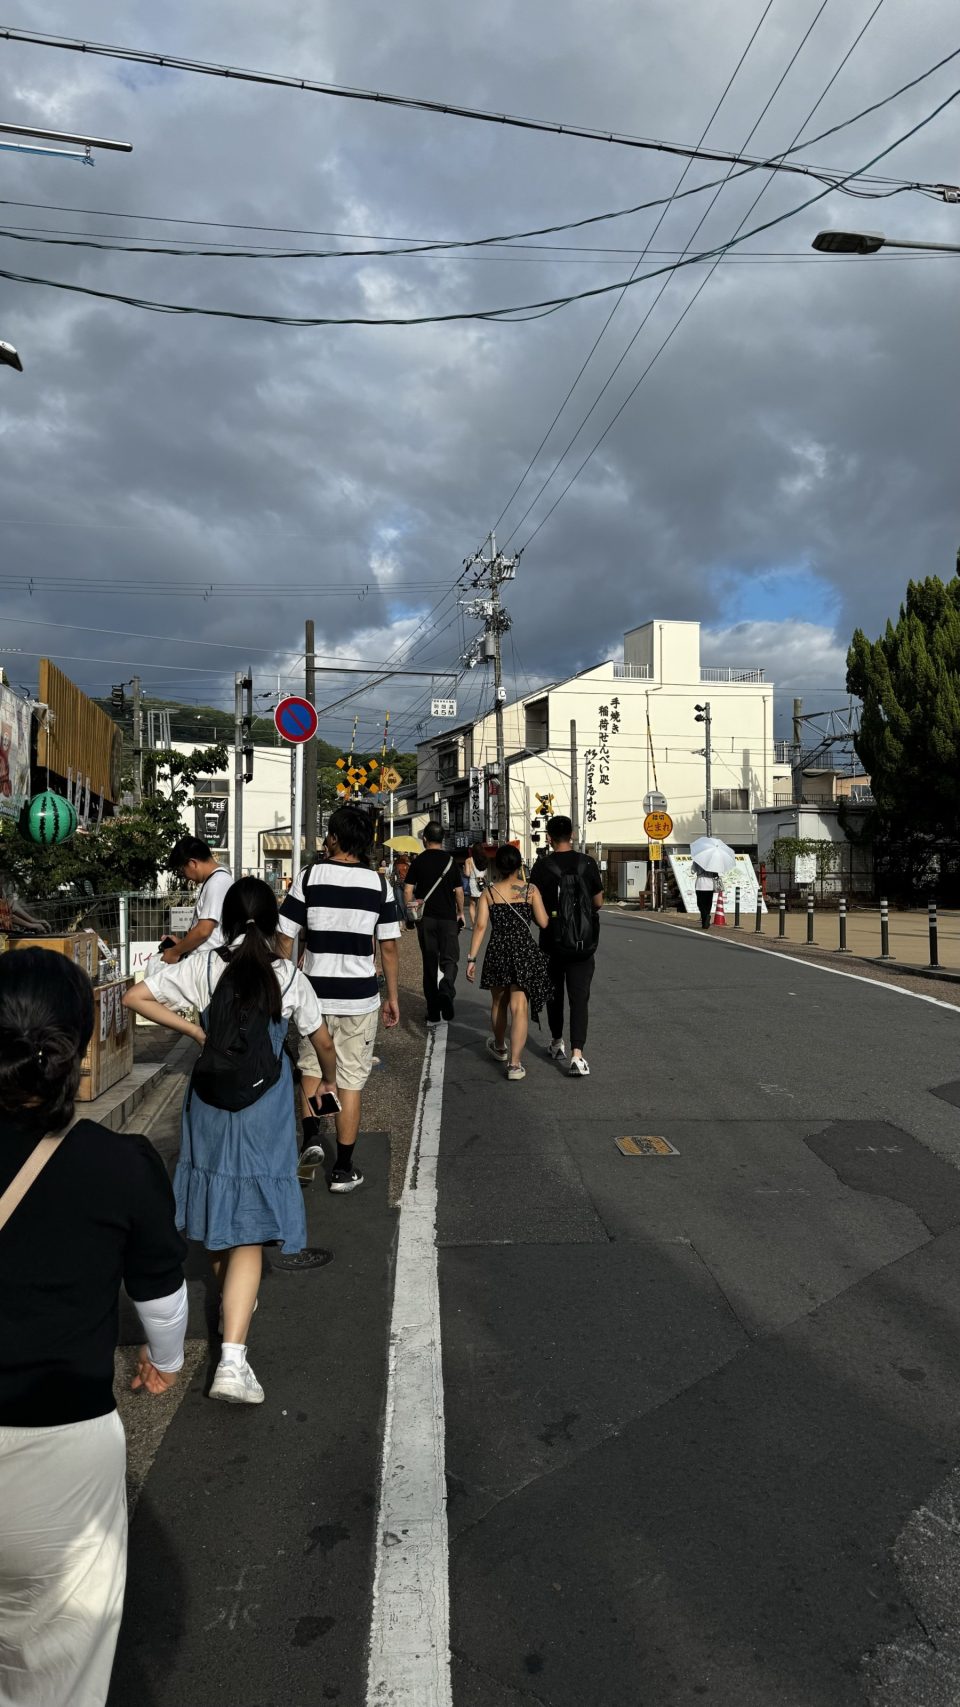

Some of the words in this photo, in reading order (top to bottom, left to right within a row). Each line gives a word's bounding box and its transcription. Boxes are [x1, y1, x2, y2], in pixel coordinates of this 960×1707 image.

[610, 697, 621, 734] 手焼き
[598, 705, 610, 786] 稲荷せんべい処
[646, 823, 670, 832] とまれ
